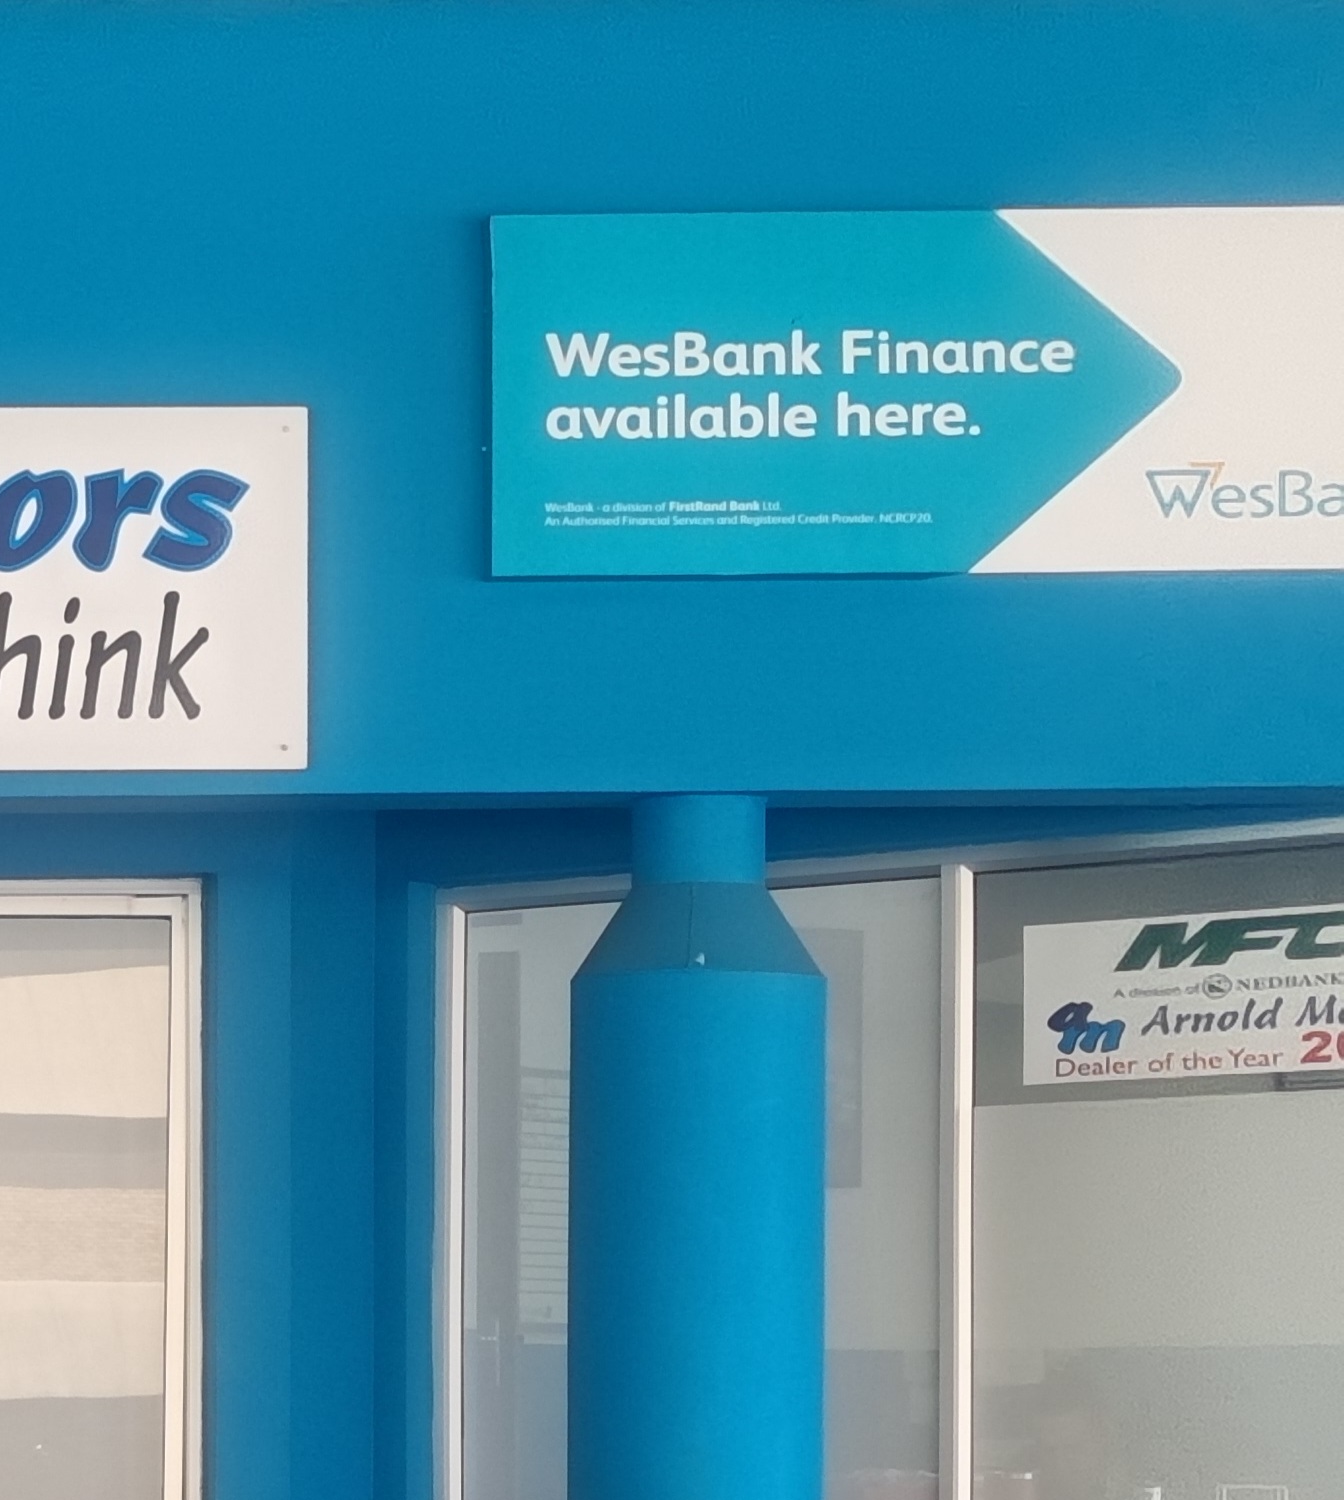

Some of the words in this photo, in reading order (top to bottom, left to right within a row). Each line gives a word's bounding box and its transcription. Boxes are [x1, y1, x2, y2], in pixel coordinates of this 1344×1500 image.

[545, 330, 823, 378] WesBank
[841, 328, 1076, 375] Finance
[545, 391, 818, 441] available
[836, 390, 982, 438] here.
[545, 502, 594, 513] WesBank
[612, 502, 653, 513] division
[655, 501, 666, 512] of
[669, 500, 727, 512] FirstRand
[729, 500, 760, 512] Bank
[762, 500, 782, 511] Ltd.
[1145, 463, 1344, 520] WesBa
[544, 515, 560, 527] An
[562, 515, 620, 527] Authorised
[622, 515, 670, 526] Financial
[672, 515, 715, 526] Services
[717, 515, 738, 526] and
[739, 514, 795, 527] Registered
[797, 513, 829, 525] Credit
[1113, 987, 1126, 999] A
[1140, 996, 1284, 1037] Arnold
[1055, 1055, 1136, 1078] Dealer
[1148, 1052, 1175, 1073] of
[1182, 1051, 1223, 1071] the
[1228, 1047, 1284, 1069] Year
